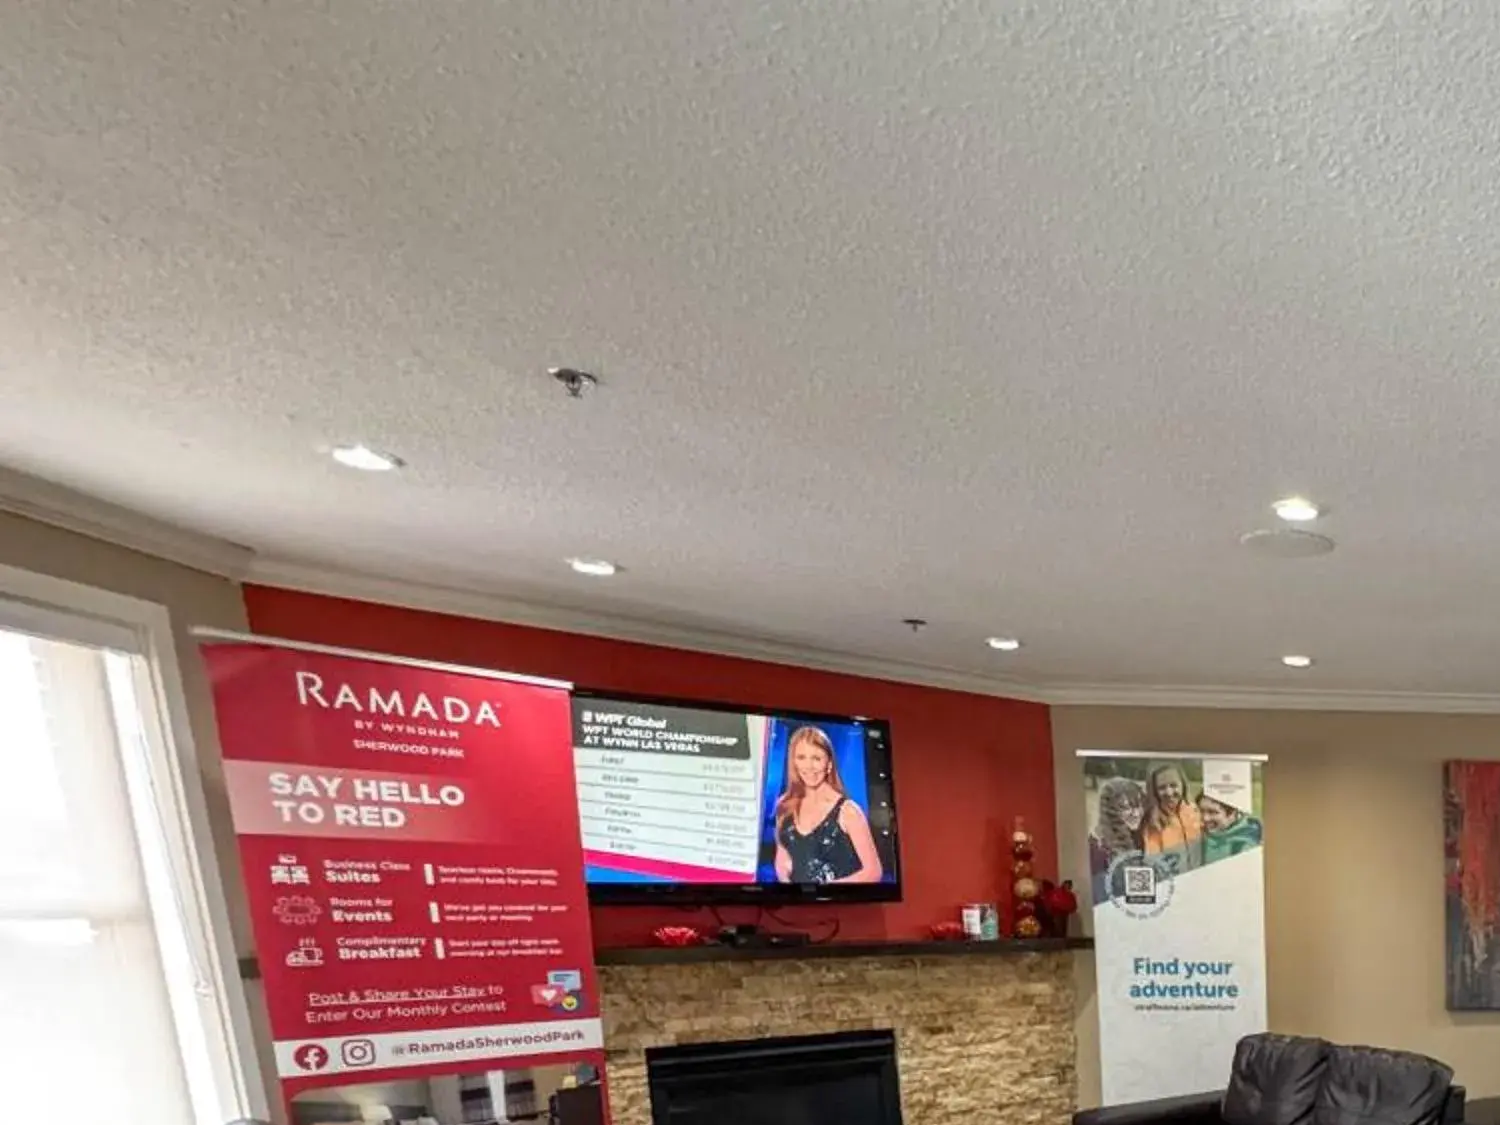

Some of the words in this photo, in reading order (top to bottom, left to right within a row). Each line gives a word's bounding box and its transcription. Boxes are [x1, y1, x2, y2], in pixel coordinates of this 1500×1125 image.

[296, 671, 502, 728] RAMADA
[354, 719, 374, 729] BY
[381, 723, 460, 739] WYNDHAM
[611, 726, 653, 739] WORLD
[655, 731, 739, 746] CHAMPIONSHIP
[353, 739, 430, 755] SHERWOOD
[431, 747, 465, 758] PARK
[583, 735, 600, 745] AT
[641, 740, 662, 750] LAS
[664, 742, 700, 752] VEGAS
[268, 772, 344, 799] SAY
[353, 778, 465, 807] HELLO
[272, 800, 325, 825] TO
[333, 803, 406, 828] RED
[325, 870, 381, 883] Suites
[332, 910, 393, 922] Events
[339, 946, 422, 959] Breakfast
[1133, 957, 1180, 975] Find
[1183, 961, 1233, 979] your
[309, 992, 344, 1005] Post
[364, 988, 410, 1001] Share
[413, 988, 448, 999] Your
[452, 985, 486, 997] Stay
[488, 984, 504, 995] to
[1129, 980, 1239, 998] adventure
[306, 1011, 347, 1023] Enter
[352, 1008, 382, 1020] Our
[387, 1003, 448, 1017] Monthly
[451, 1000, 507, 1014] Contest
